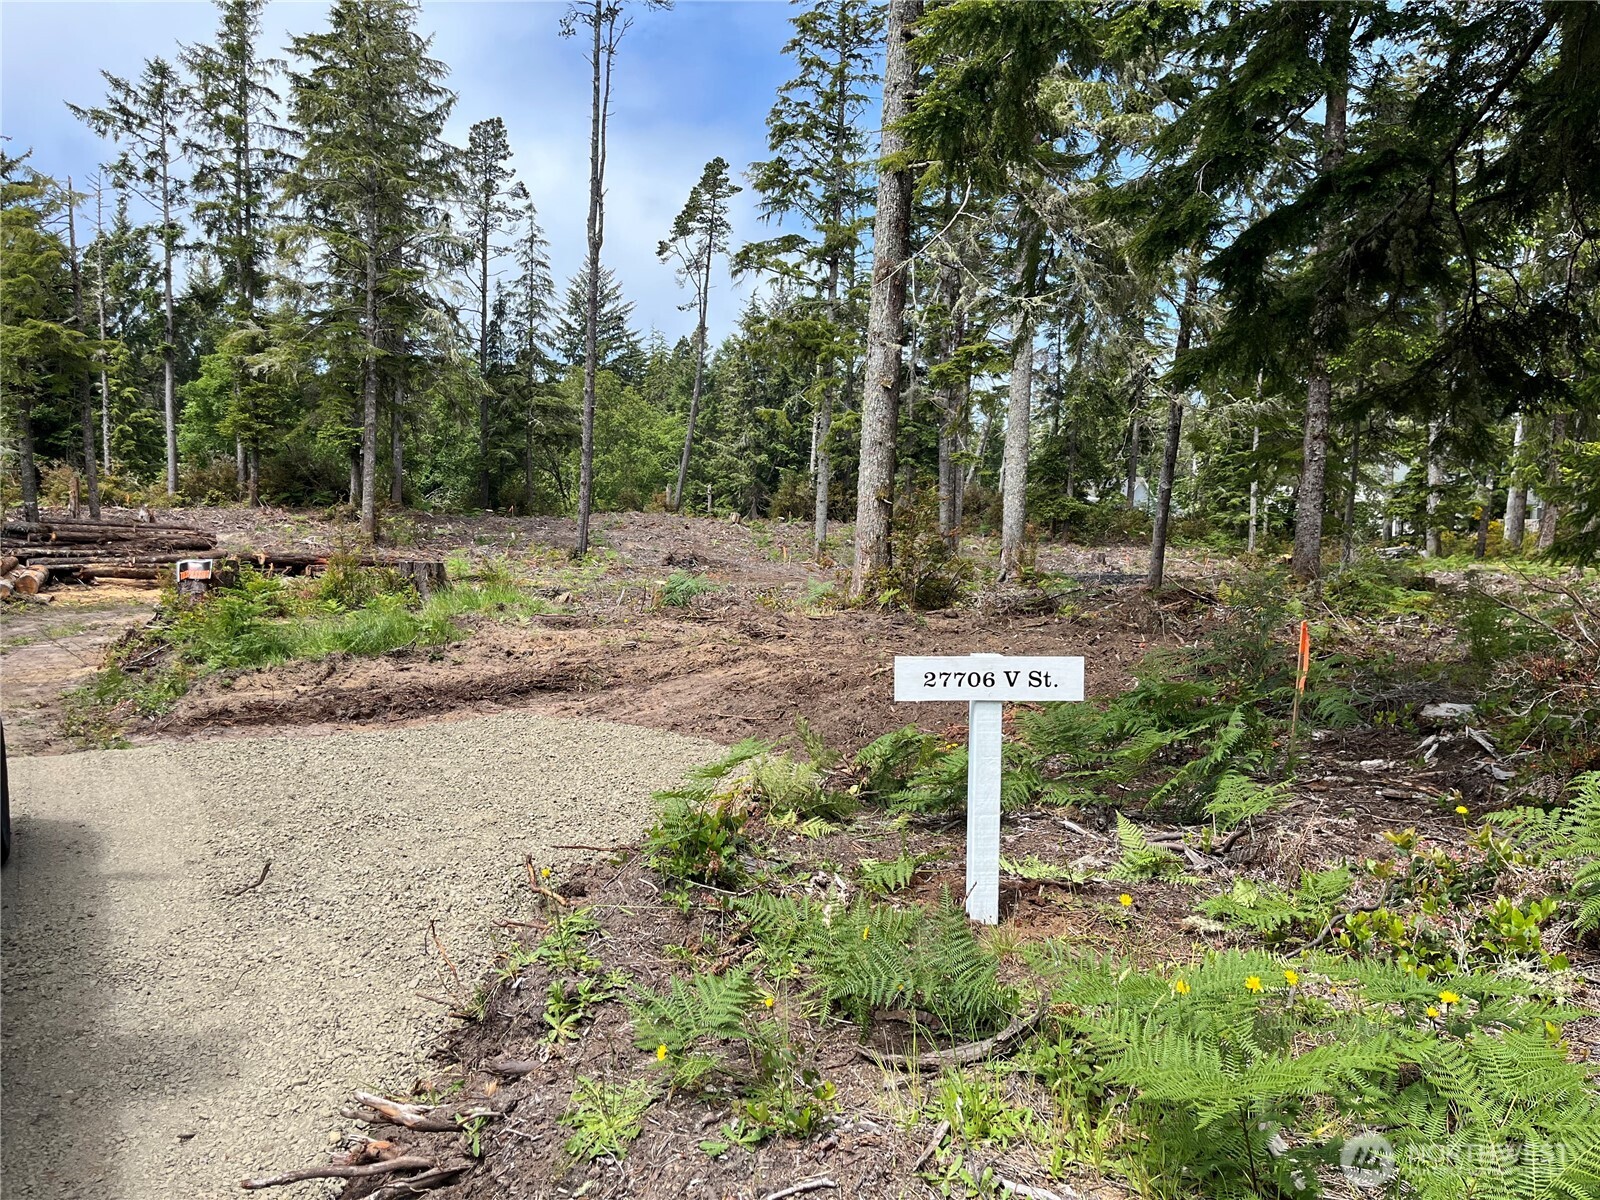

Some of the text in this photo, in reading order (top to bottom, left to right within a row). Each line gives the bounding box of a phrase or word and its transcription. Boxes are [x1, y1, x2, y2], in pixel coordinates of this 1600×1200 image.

[923, 670, 1059, 688] 27706 V St.
